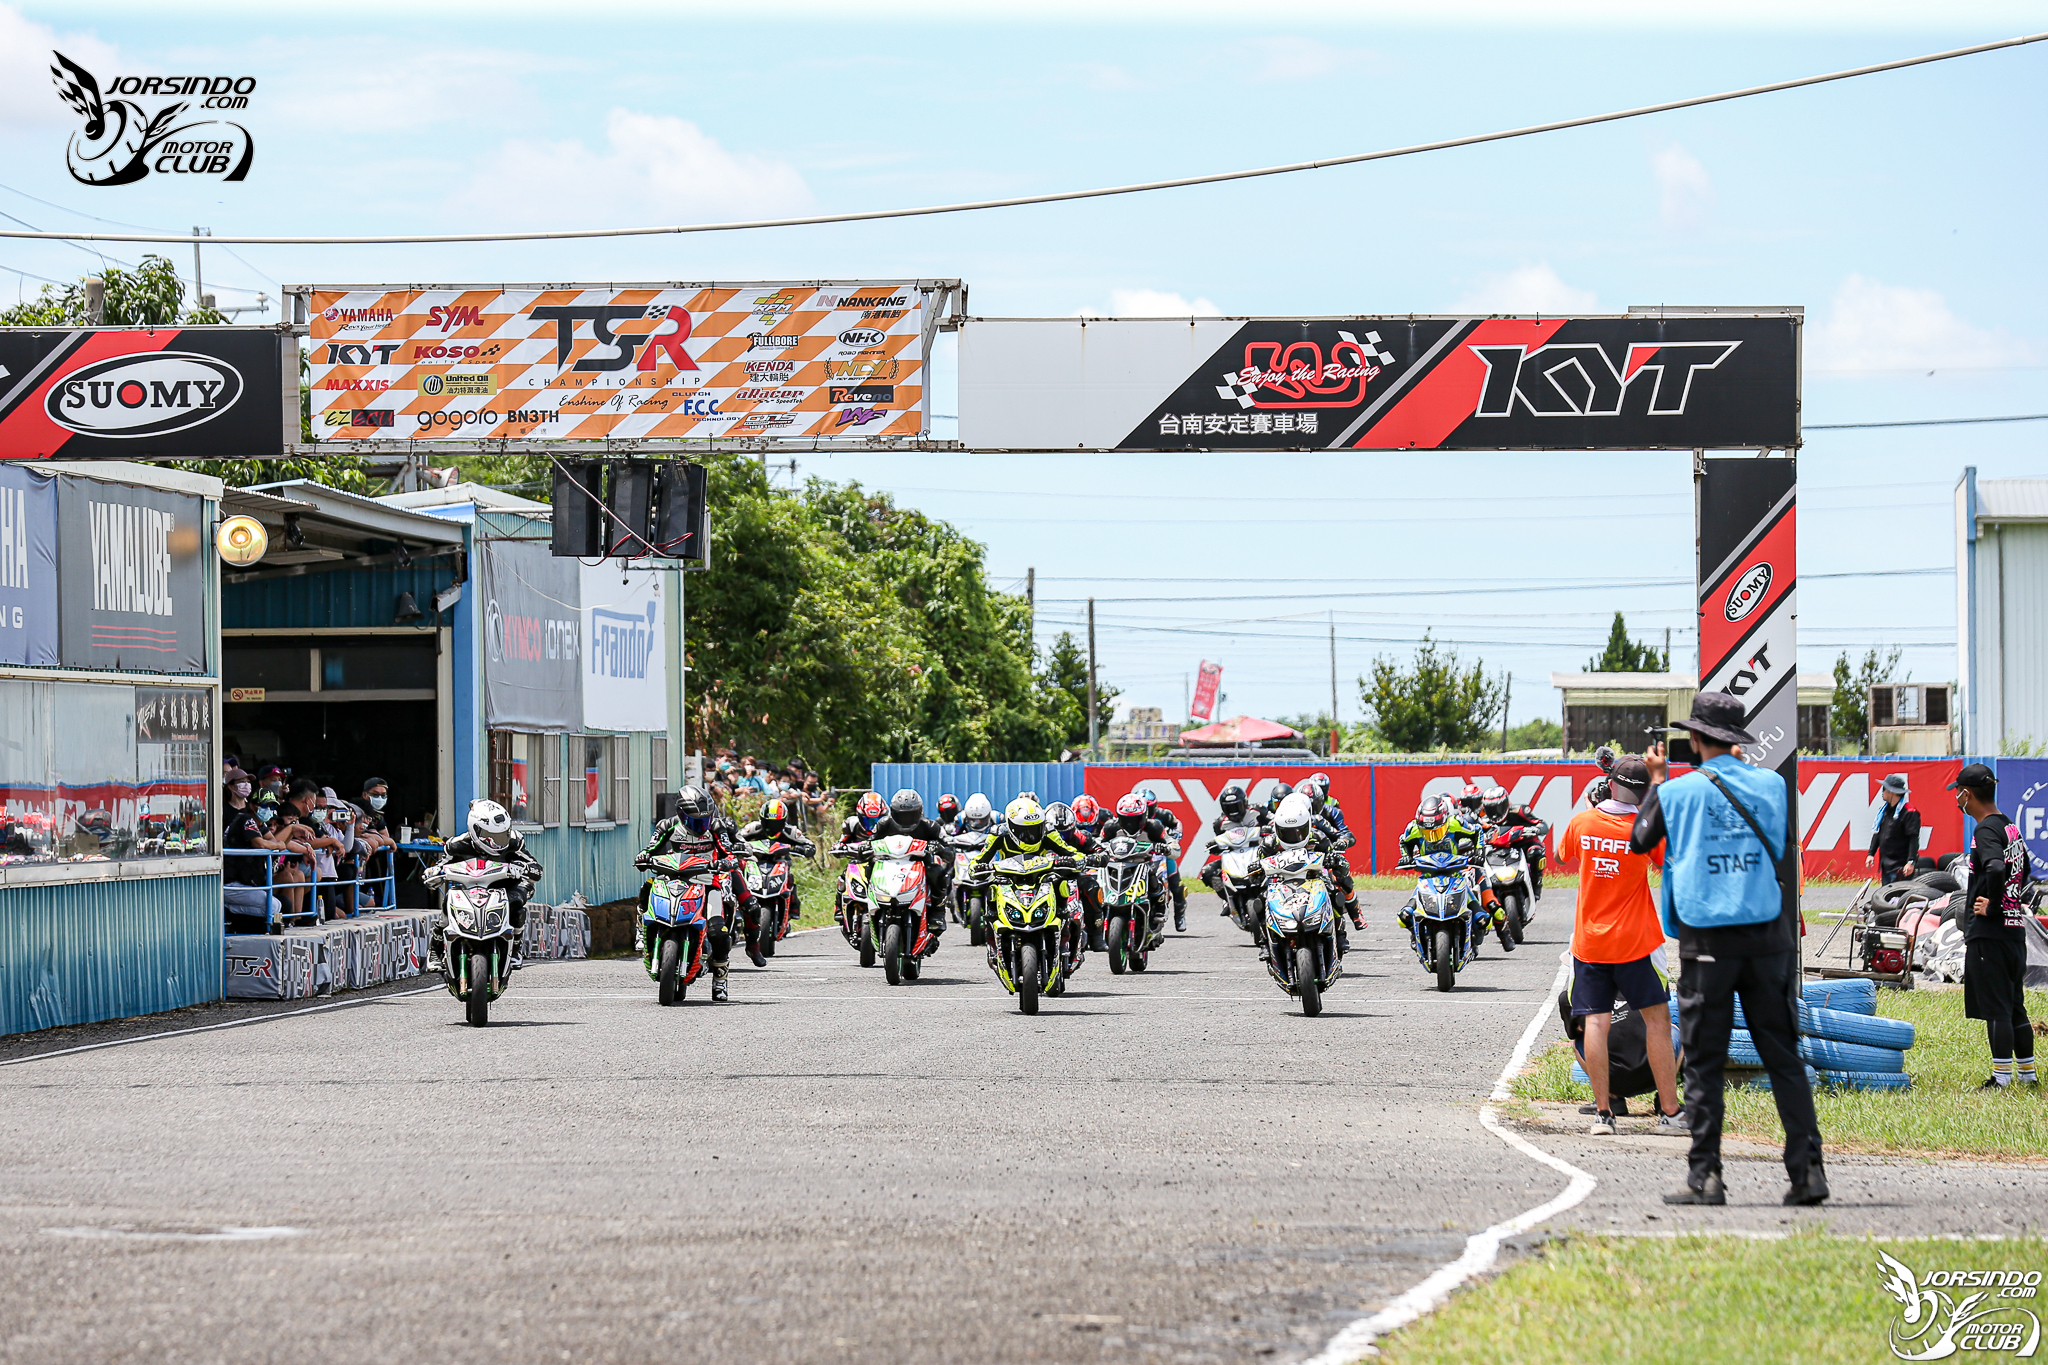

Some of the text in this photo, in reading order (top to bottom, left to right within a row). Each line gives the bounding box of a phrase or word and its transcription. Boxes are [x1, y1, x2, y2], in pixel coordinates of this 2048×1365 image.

[837, 296, 908, 307] NANKANG
[341, 308, 394, 322] YAMAHA
[425, 306, 484, 332] SYM
[528, 305, 702, 374] TSR
[753, 335, 798, 346] FULL BORE
[326, 343, 401, 365] KYT
[413, 345, 480, 359] KOSO
[744, 360, 796, 372] KENDA
[528, 377, 701, 387] CHAMPIONSHIP
[749, 373, 789, 382] 建大輪胎
[1236, 362, 1381, 388] Enjoy the Racing
[1467, 340, 1744, 417] KYT
[325, 379, 390, 391] MAXXIS
[735, 387, 804, 399] aRacer
[65, 379, 222, 409] SUOMY
[832, 388, 892, 402] Reveno
[610, 394, 624, 412] Of
[628, 395, 669, 410] Racing
[684, 399, 724, 416] F.C.C.
[417, 407, 498, 432] gogoro
[507, 409, 559, 423] BN3TH
[1158, 412, 1319, 436] 台南安定賽車場
[88, 500, 173, 617] YAMALUBE
[1726, 567, 1771, 617] SUOMY
[503, 614, 542, 662] KYMCO
[1591, 856, 1620, 873] TSR
[1707, 852, 1761, 875] STAFF
[680, 899, 697, 915] 38
[226, 955, 273, 979] TSR
